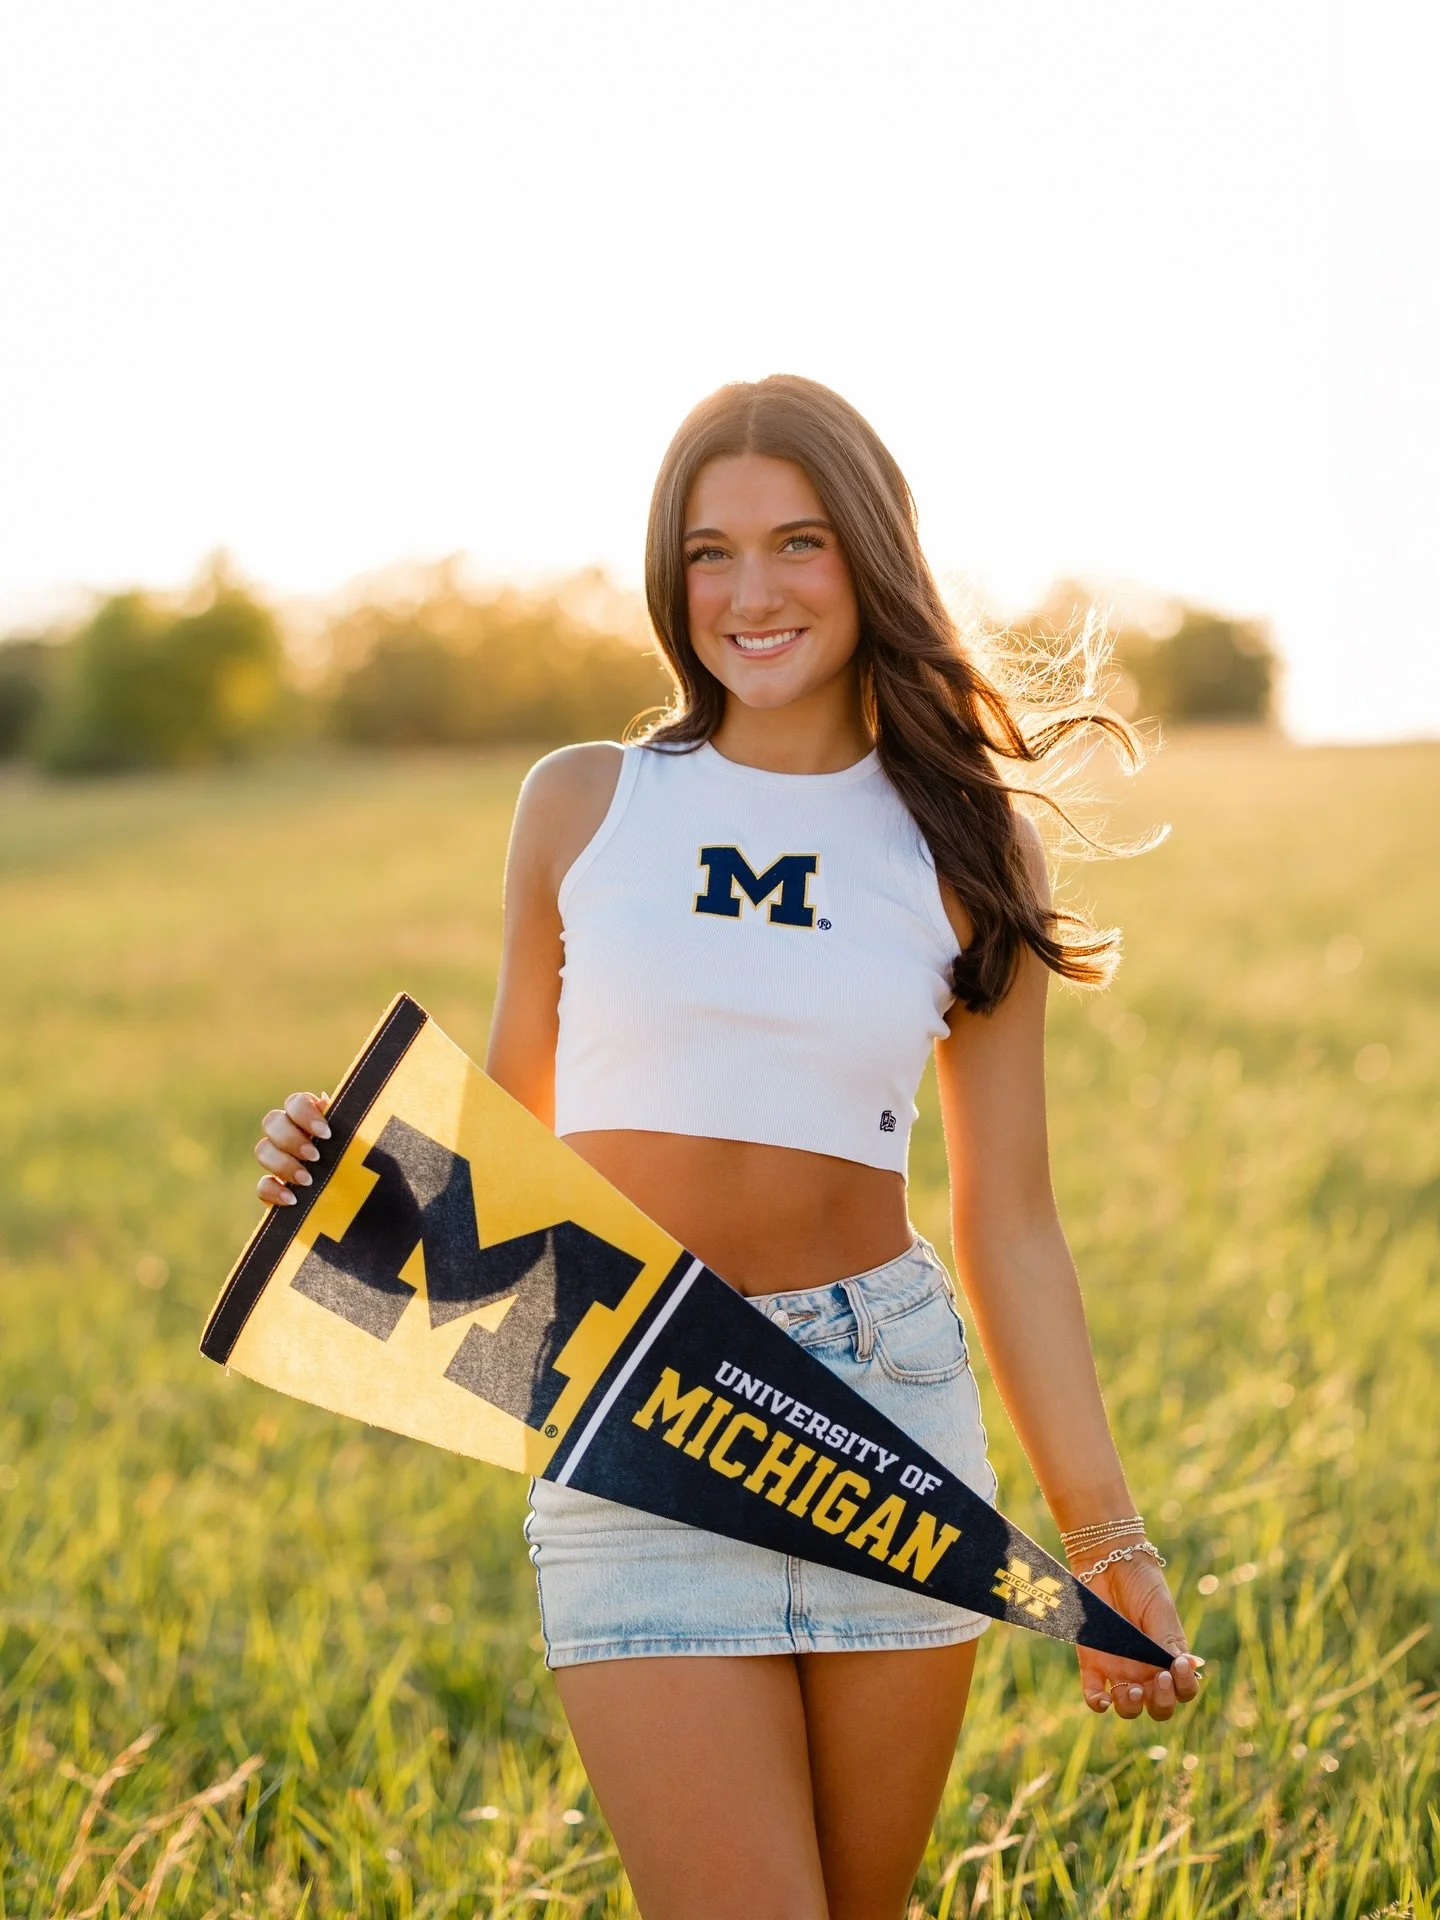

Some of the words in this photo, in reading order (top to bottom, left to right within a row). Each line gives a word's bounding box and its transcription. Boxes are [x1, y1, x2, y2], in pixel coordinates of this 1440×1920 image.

[693, 844, 820, 930] M
[290, 1115, 646, 1432] M
[632, 1366, 962, 1583] MICHIGAN
[714, 1360, 899, 1473] UNIVERSITY
[900, 1464, 943, 1494] OF
[1003, 1574, 1052, 1602] MICHIGAN
